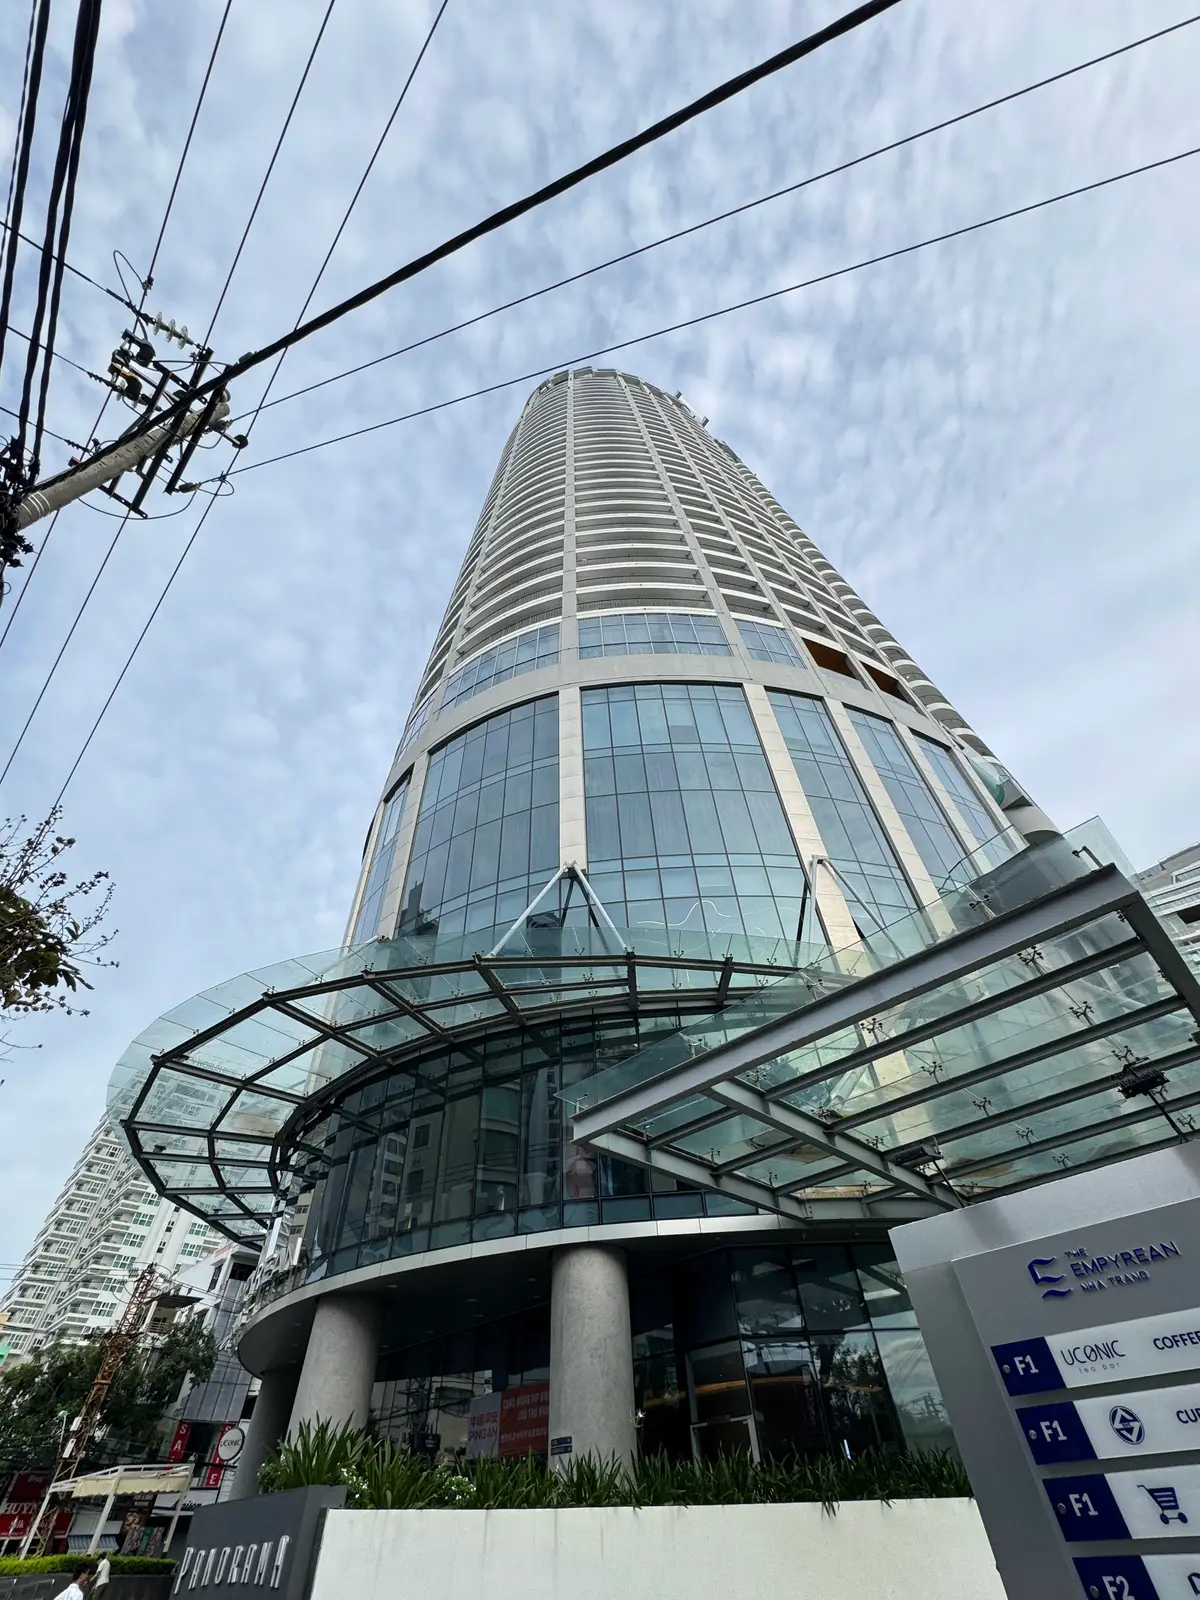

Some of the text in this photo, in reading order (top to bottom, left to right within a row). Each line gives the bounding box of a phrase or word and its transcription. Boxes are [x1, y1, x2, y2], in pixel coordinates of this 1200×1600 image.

[1064, 1248, 1090, 1260] THE
[1070, 1240, 1182, 1277] EMPYREAN
[1080, 1269, 1151, 1292] NHA TRANG
[1014, 1354, 1039, 1376] F1
[1040, 1420, 1067, 1442] F1
[1069, 1493, 1099, 1517] F1
[174, 1535, 290, 1595] PANORAMA
[1102, 1575, 1136, 1600] F2
